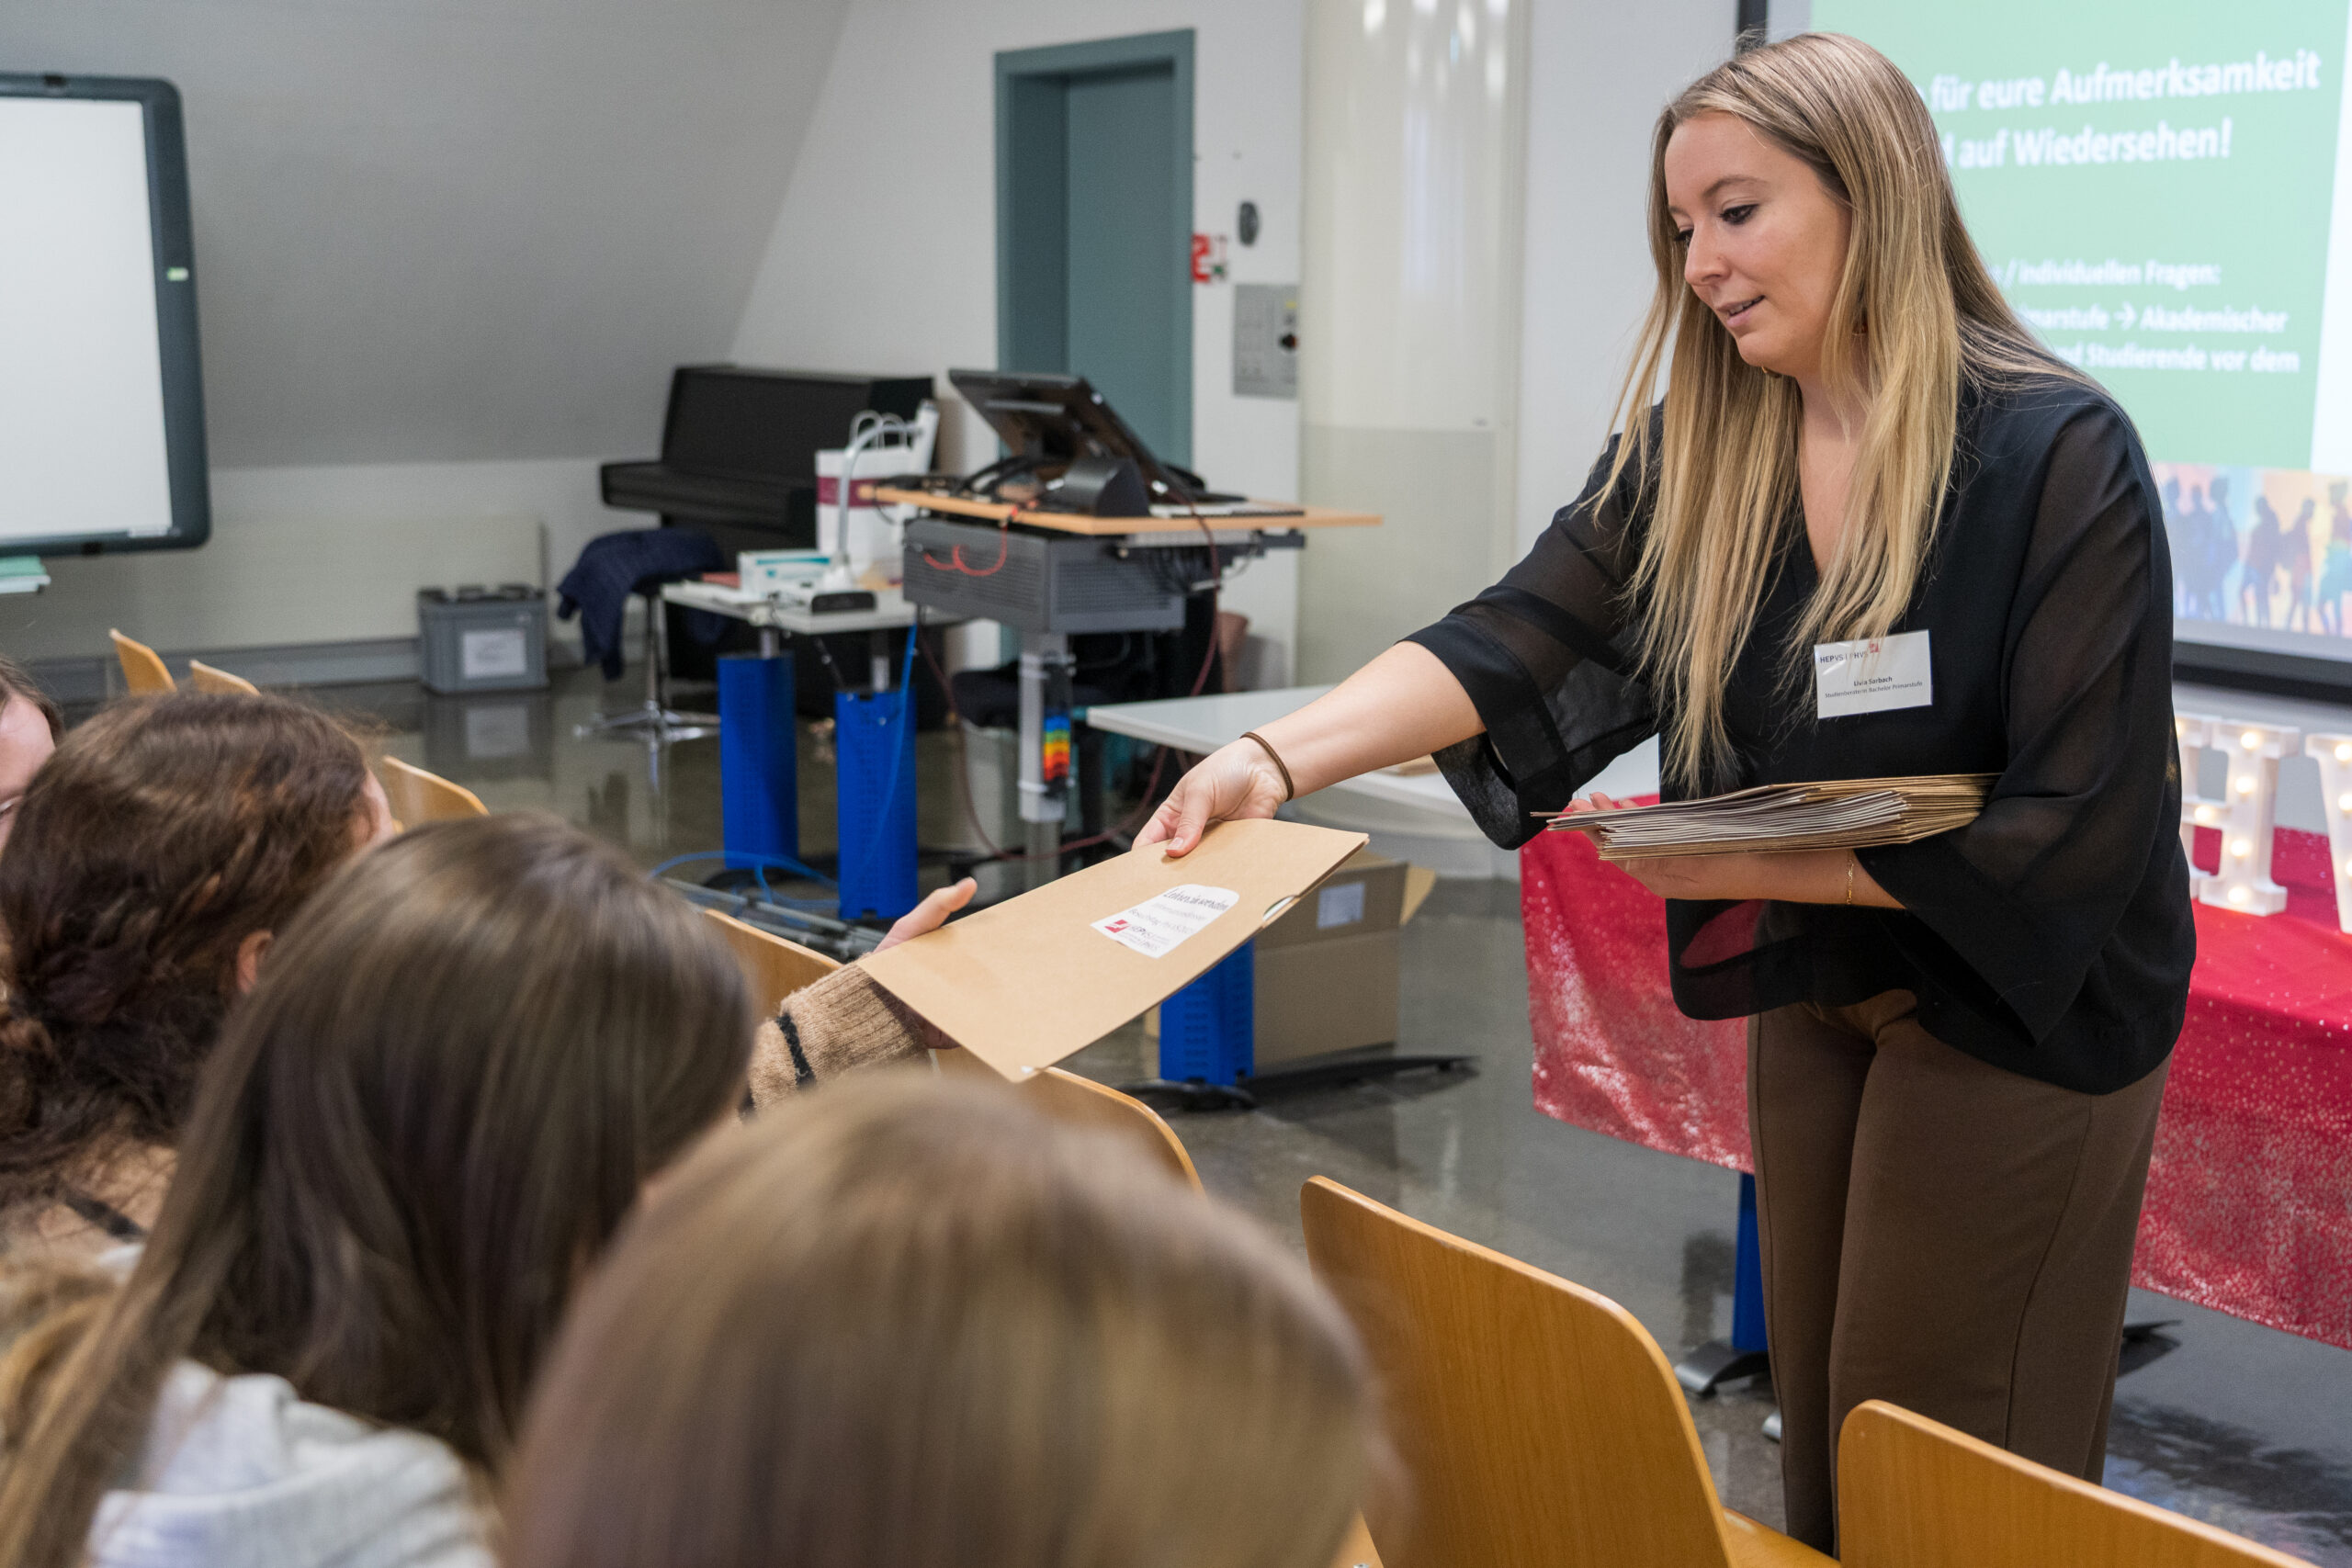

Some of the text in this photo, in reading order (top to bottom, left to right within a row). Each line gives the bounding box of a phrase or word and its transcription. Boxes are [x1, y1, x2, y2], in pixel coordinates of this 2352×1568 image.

[1931, 50, 2321, 111] für eure Aufmerksamkeit
[1959, 128, 2009, 169] auf
[2013, 118, 2233, 165] Wiedersehen!
[2146, 259, 2222, 291] Fragen:
[2141, 304, 2289, 332] Akademischer
[2086, 344, 2207, 369] Studierende
[2211, 351, 2247, 371] vor
[2251, 345, 2300, 372] dem
[1820, 654, 1844, 663] HEPVS
[1869, 677, 1893, 685] Sarbach
